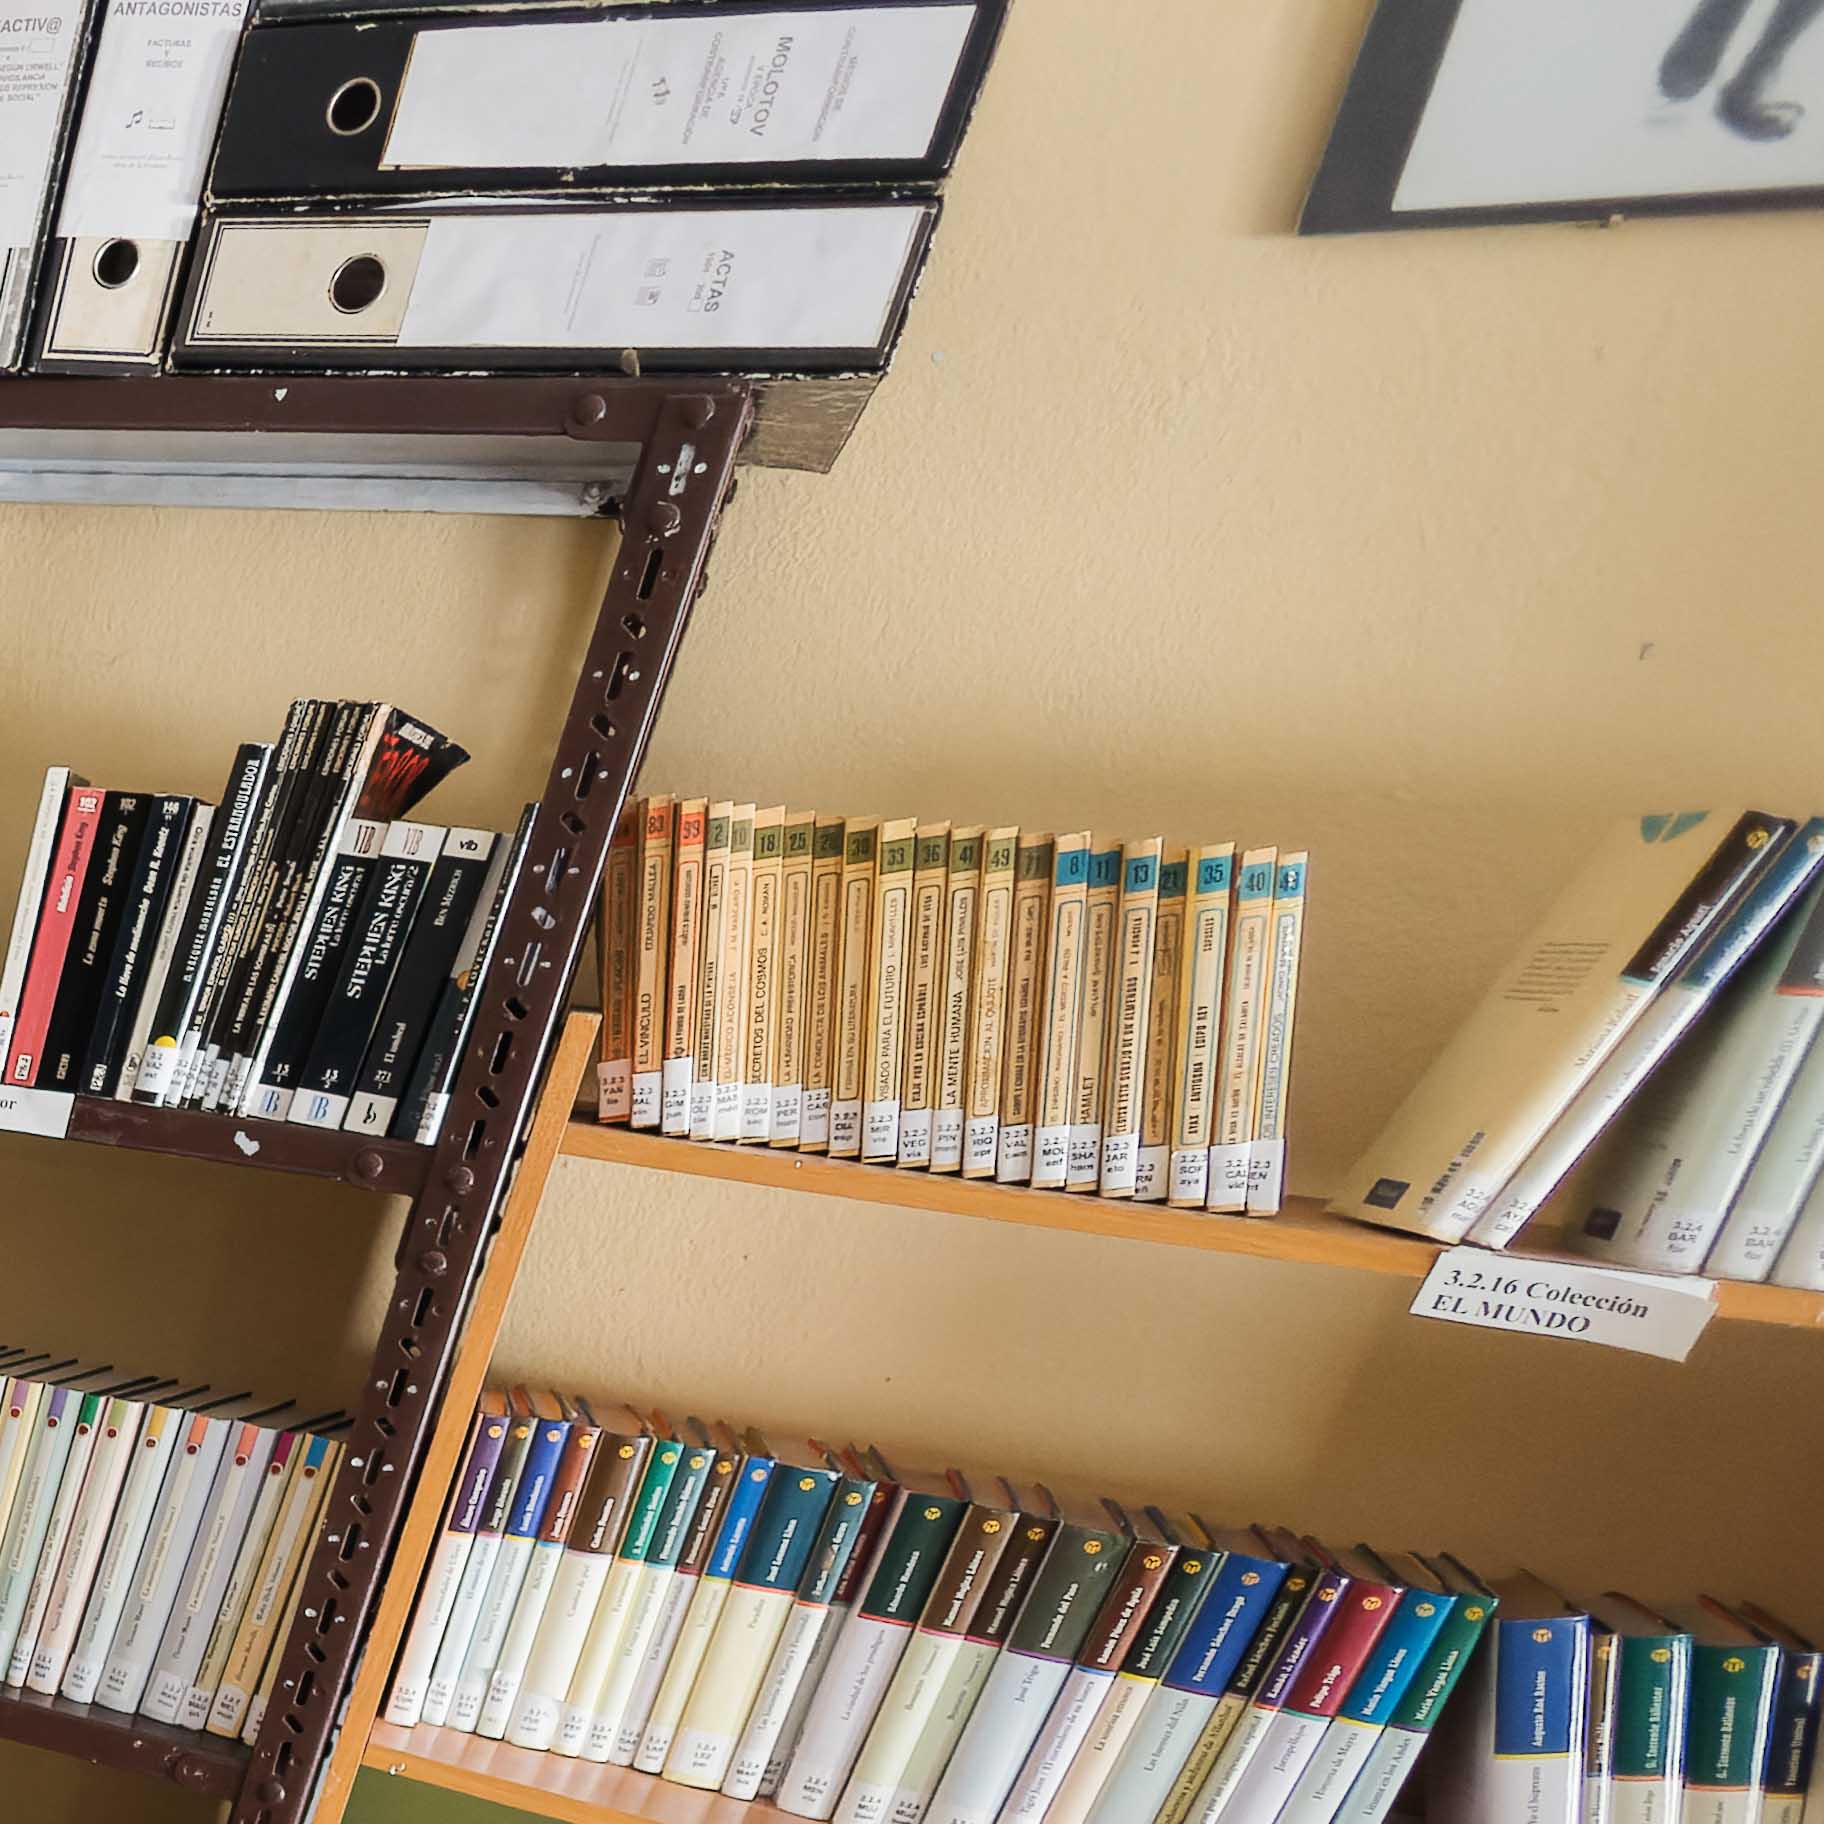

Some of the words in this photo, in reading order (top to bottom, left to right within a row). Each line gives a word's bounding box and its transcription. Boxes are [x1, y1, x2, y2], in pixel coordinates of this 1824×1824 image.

[112, 1, 242, 17] ANTAGONISTAS
[749, 36, 794, 137] MOLOTOV
[704, 249, 735, 313] ACTAS
[221, 758, 261, 850] ESTRANGULADOR
[714, 823, 724, 843] 2
[759, 833, 775, 852] 18
[216, 850, 232, 869] EL
[887, 846, 905, 866] 33
[958, 845, 974, 866] 41
[990, 846, 1010, 867] 49
[1069, 854, 1080, 875] 8
[1096, 858, 1110, 878] 11
[1133, 863, 1149, 883] 13
[1204, 863, 1225, 883] 35
[1246, 872, 1264, 892] 40
[304, 905, 342, 981] STEPHEN
[330, 864, 355, 907] KING
[345, 913, 386, 1000] STEPHEN
[379, 862, 409, 916] KING
[185, 932, 205, 973] VAZQUEZ
[755, 947, 769, 1004] COSMOS
[884, 962, 897, 1010] FUTURO
[640, 992, 652, 1045] VINCULO
[952, 991, 963, 1044] HUMANA
[751, 1033, 766, 1085] SECRETOS
[881, 1029, 894, 1061] PARA
[878, 1061, 892, 1104] VISADO
[950, 1050, 960, 1086] MENTE
[1081, 1075, 1095, 1126] HAMLET
[1668, 1232, 1697, 1243] BAR
[1443, 1269, 1519, 1295] 3.2.16
[1526, 1281, 1649, 1319] Colección
[1432, 1293, 1467, 1314] EL
[1474, 1298, 1592, 1335] MUNDO
[887, 1579, 906, 1613] Eduardo
[898, 1550, 921, 1583] Mendoza
[1041, 1612, 1062, 1650] Fernando
[1135, 1652, 1151, 1670] José
[1146, 1632, 1160, 1653] Luis
[1153, 1597, 1180, 1635] Sampedro
[1192, 1645, 1217, 1683] Fernando
[1208, 1615, 1233, 1649] Sánchez
[1225, 1595, 1247, 1620] Dragó
[1097, 1639, 1118, 1665] Ramón
[1288, 1636, 1310, 1666] Sender
[1308, 1682, 1330, 1711] Felipe
[1360, 1693, 1378, 1718] Mario
[1370, 1668, 1394, 1697] Vargas
[1386, 1648, 1409, 1674] Llosa
[1413, 1696, 1431, 1722] Mario
[1423, 1670, 1447, 1700] Vargas
[1439, 1649, 1461, 1675] Llosa
[1390, 1736, 1414, 1767] Andes
